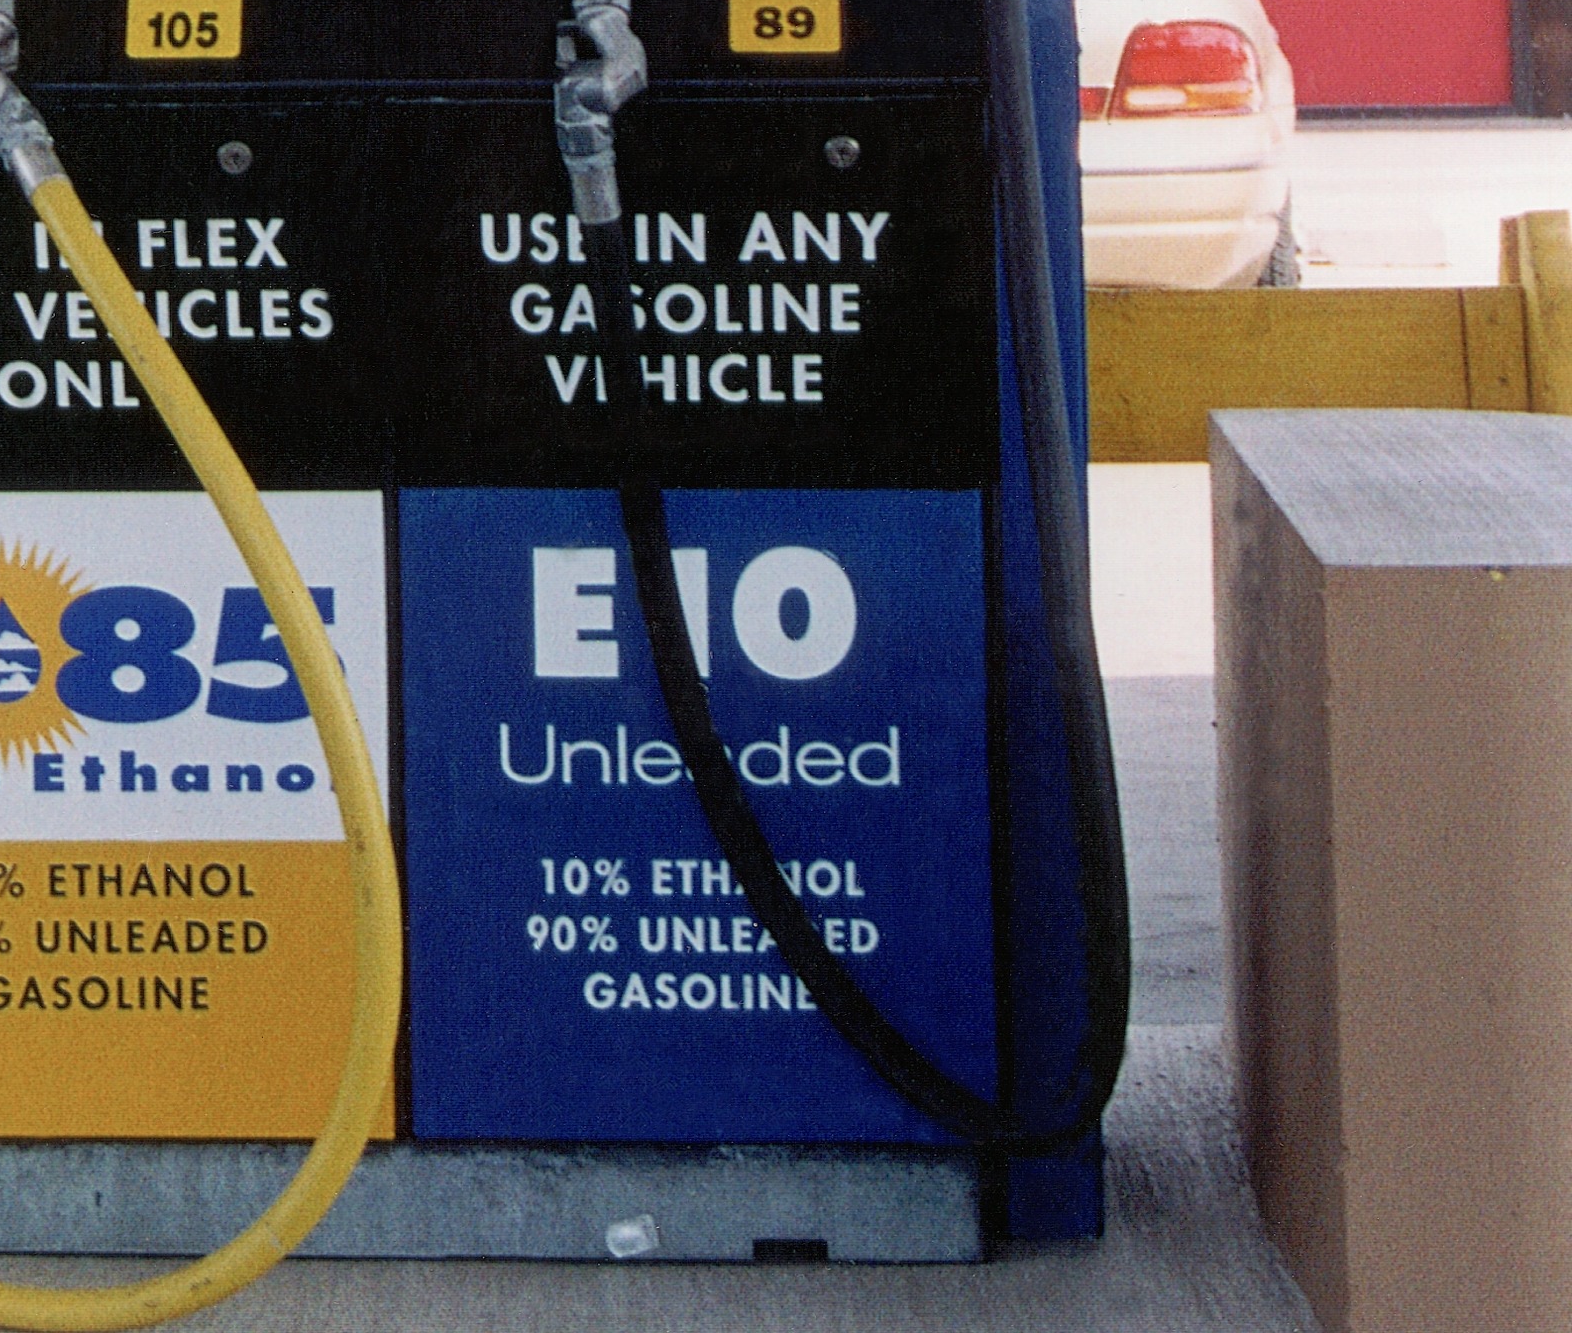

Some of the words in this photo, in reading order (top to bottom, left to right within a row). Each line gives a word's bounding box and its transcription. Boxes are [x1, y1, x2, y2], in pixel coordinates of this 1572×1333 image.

[148, 11, 218, 49] 105
[753, 6, 816, 39] 89
[34, 220, 104, 269] I
[137, 219, 288, 270] FLEX
[635, 212, 706, 262] IN
[738, 211, 891, 263] ANY
[14, 289, 333, 341] VEICLES
[33, 750, 335, 793] Ethano
[500, 723, 900, 786] Unleded
[48, 863, 255, 898] ETHANOL
[541, 857, 630, 896] 10%
[652, 858, 865, 897] ETHNOL
[35, 920, 268, 954] UNLEADED
[528, 915, 618, 954] 90%
[639, 916, 879, 955] UNLEAED
